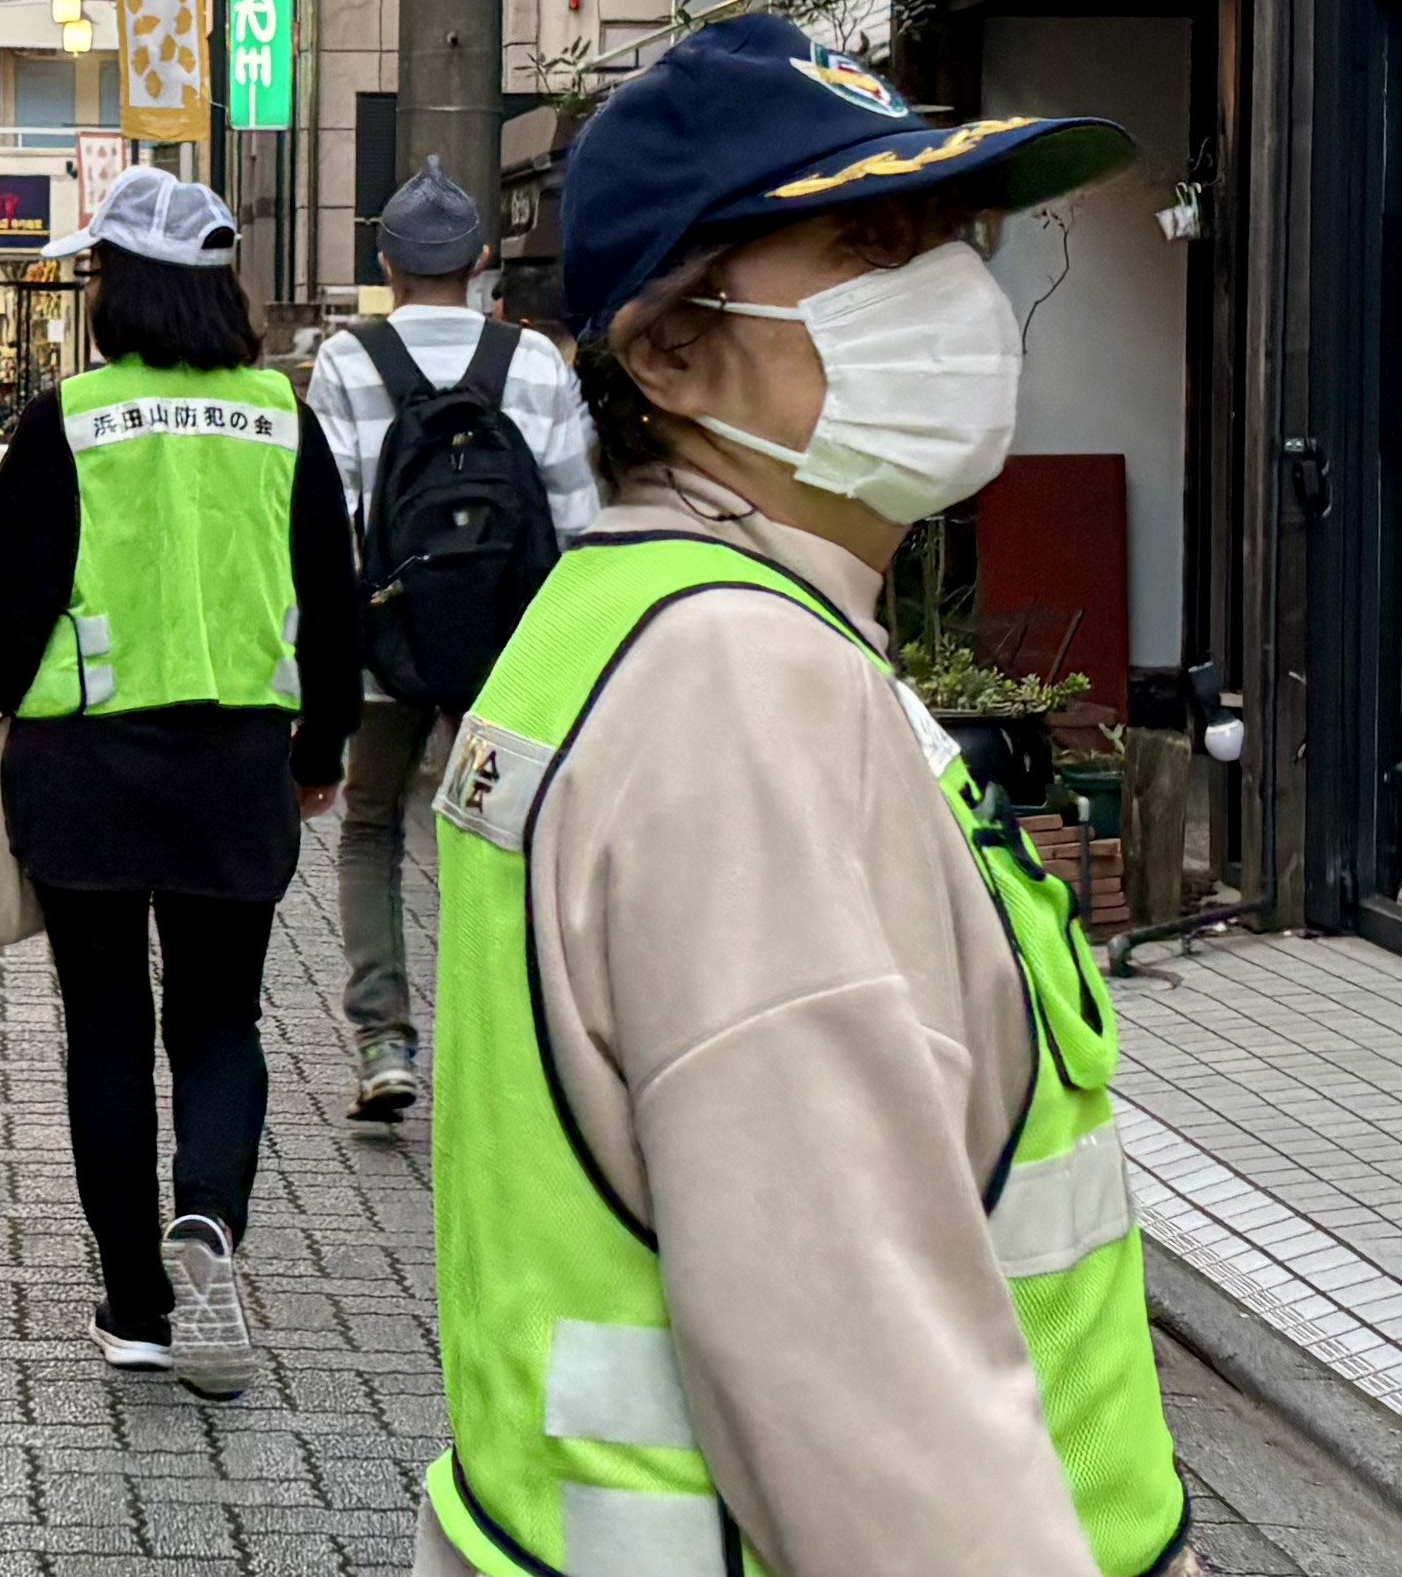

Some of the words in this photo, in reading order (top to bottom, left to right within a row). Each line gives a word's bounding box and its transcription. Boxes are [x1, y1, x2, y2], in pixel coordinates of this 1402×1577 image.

[93, 403, 273, 439] 浜田山防犯の会
